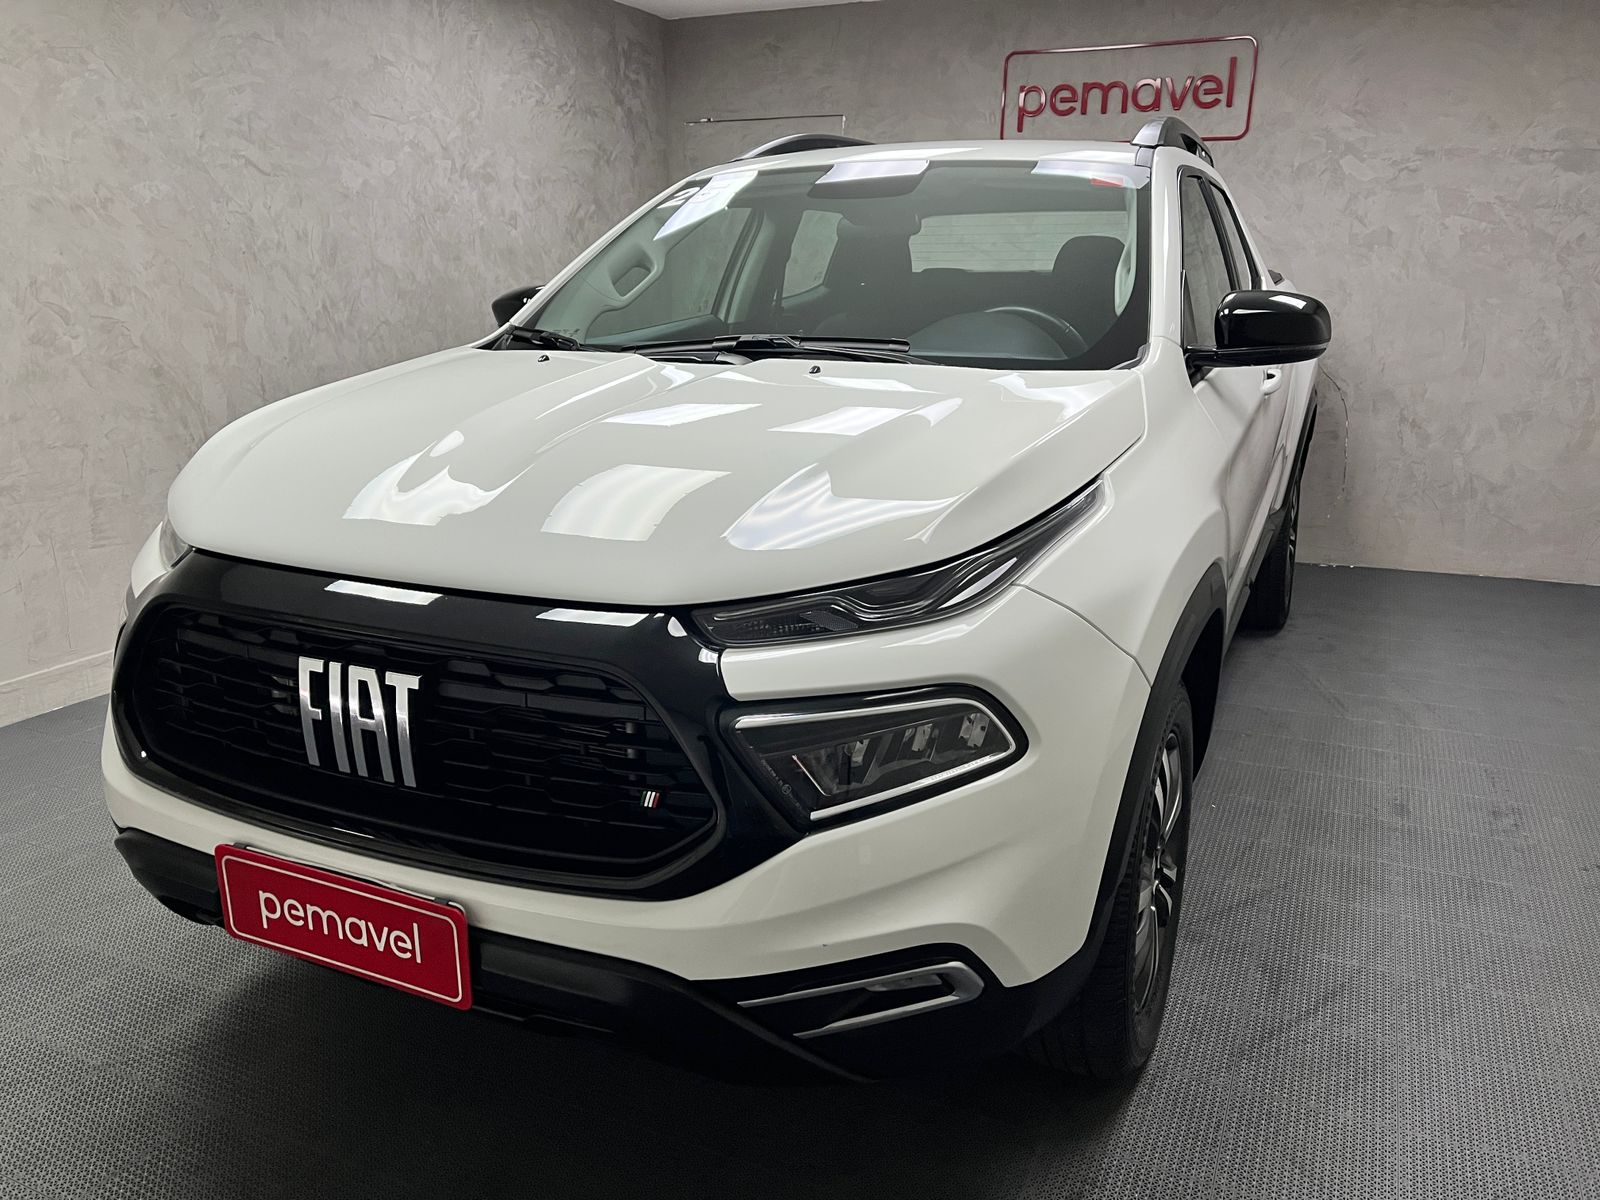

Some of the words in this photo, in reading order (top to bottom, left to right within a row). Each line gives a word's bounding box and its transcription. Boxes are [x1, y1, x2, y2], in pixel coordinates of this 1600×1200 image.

[1016, 56, 1238, 133] pemavel
[298, 655, 422, 788] FIAT
[258, 889, 422, 964] pemavel
